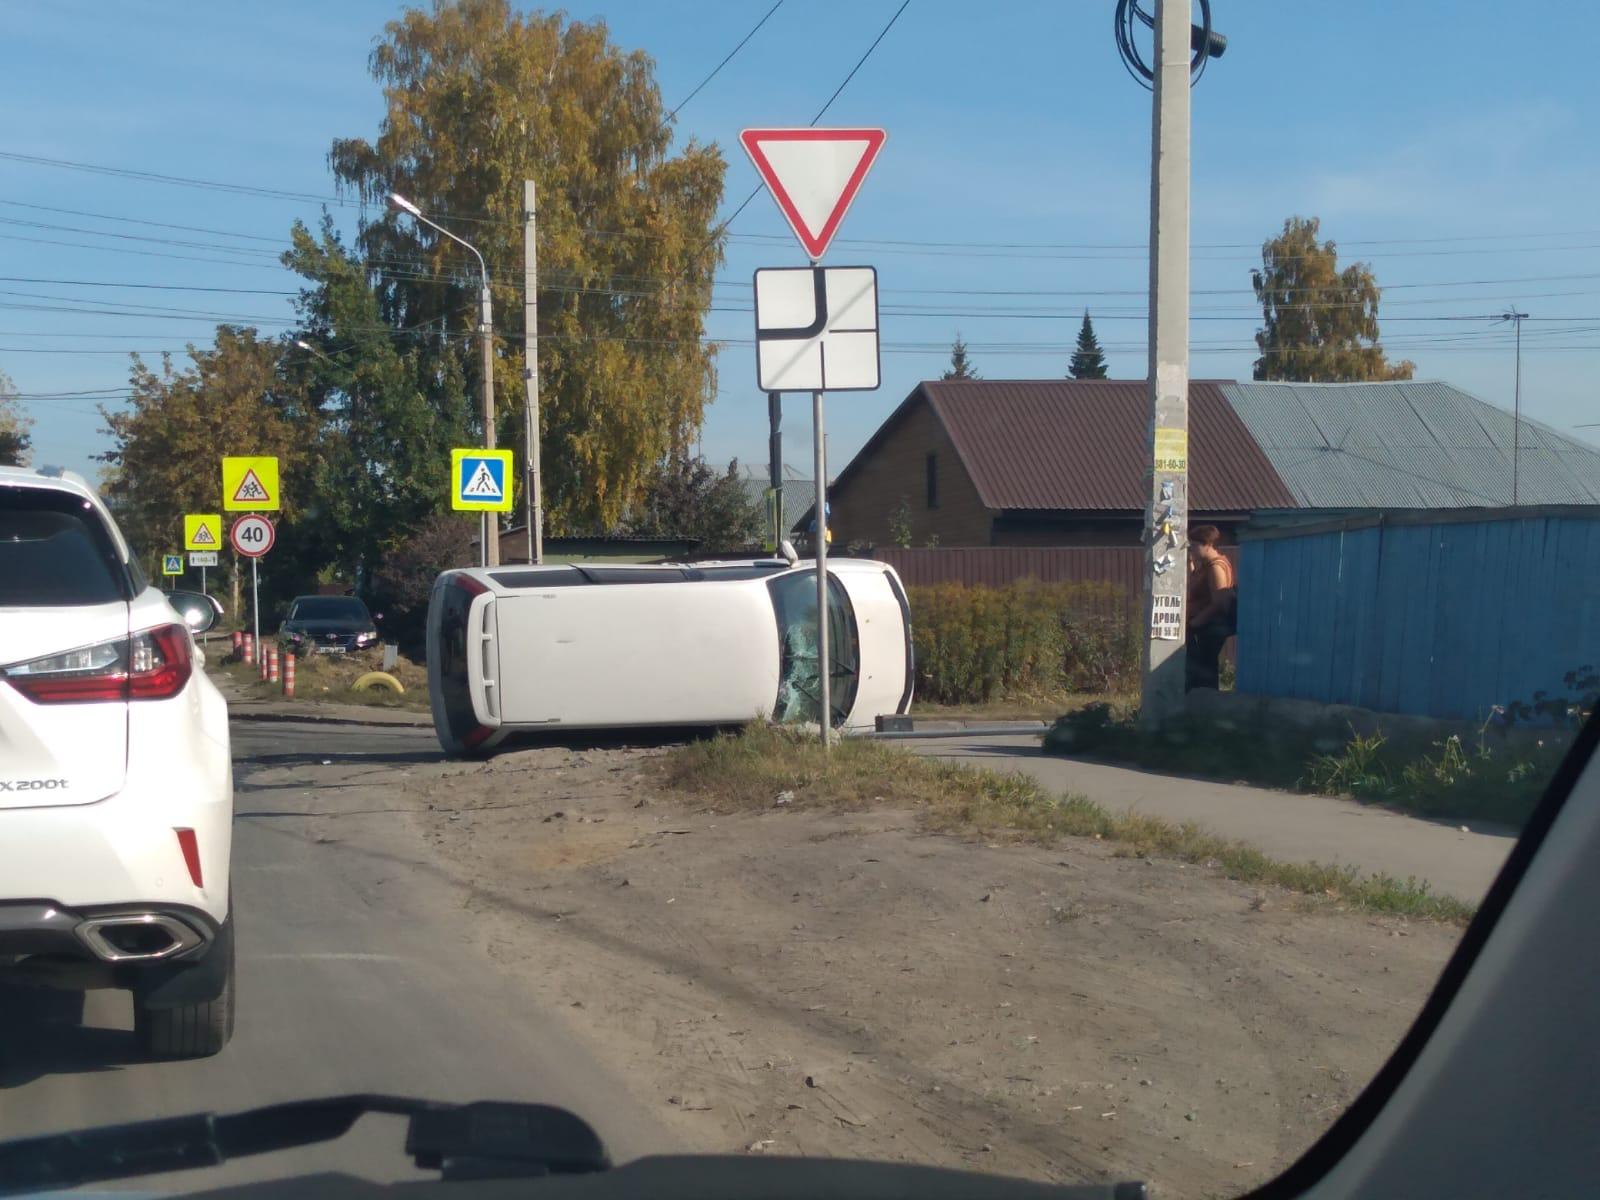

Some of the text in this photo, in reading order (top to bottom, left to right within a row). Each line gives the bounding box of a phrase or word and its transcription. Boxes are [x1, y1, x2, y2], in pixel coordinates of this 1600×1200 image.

[241, 526, 263, 543] 40
[1154, 596, 1181, 608] УГОЛЬ
[1153, 612, 1180, 625] ДРОВА
